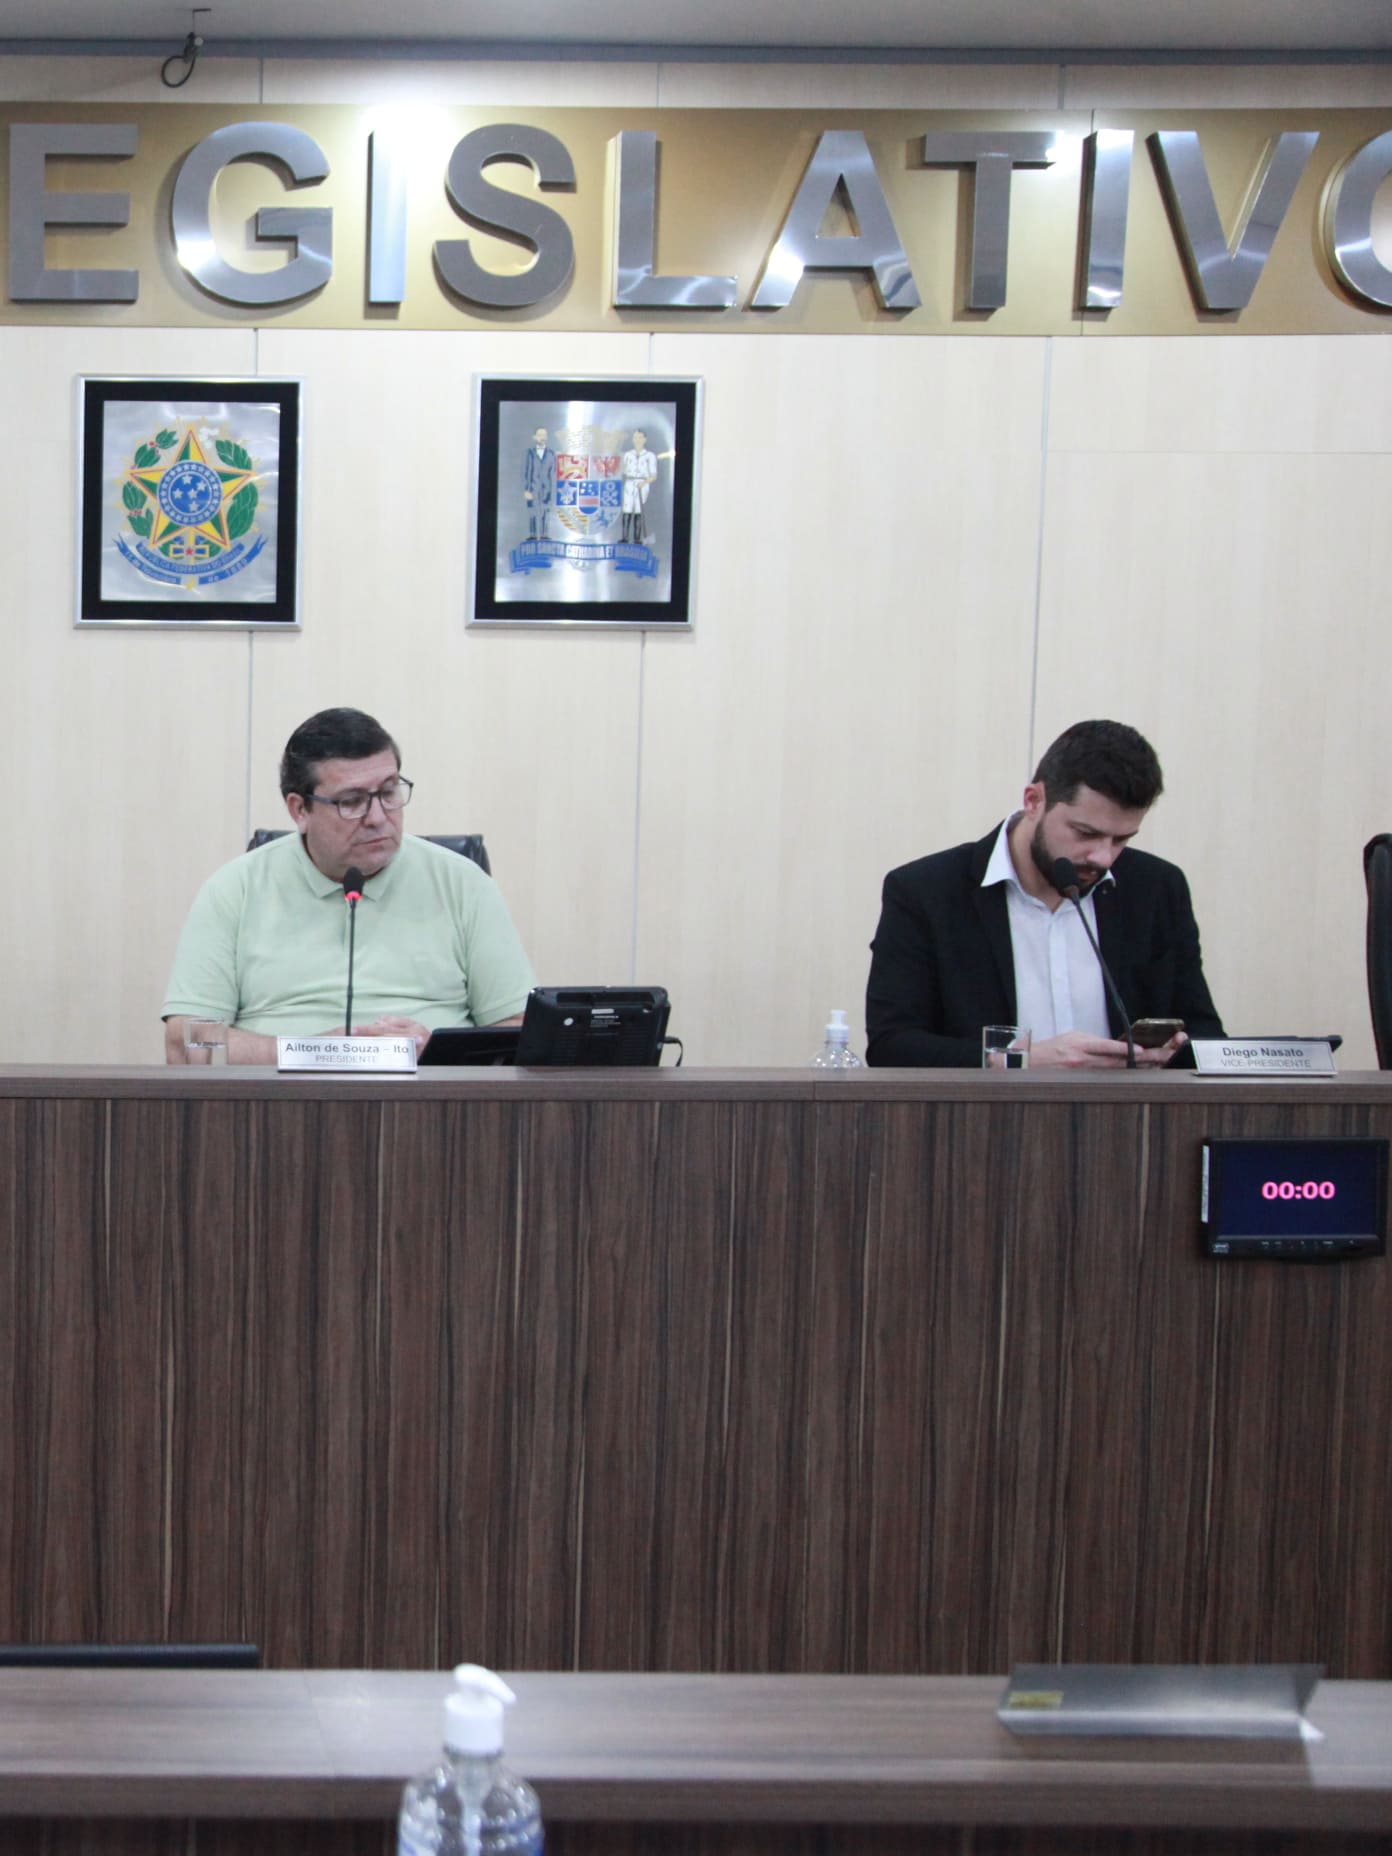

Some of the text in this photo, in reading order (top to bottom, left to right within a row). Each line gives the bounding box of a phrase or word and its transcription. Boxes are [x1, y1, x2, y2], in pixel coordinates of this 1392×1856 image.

[285, 1042, 321, 1053] Ailton
[324, 1042, 339, 1053] de
[342, 1043, 380, 1054] Souza
[1222, 1047, 1258, 1058] Diego
[315, 1054, 378, 1064] PRESIDENTE
[1261, 1181, 1336, 1200] 00:00
